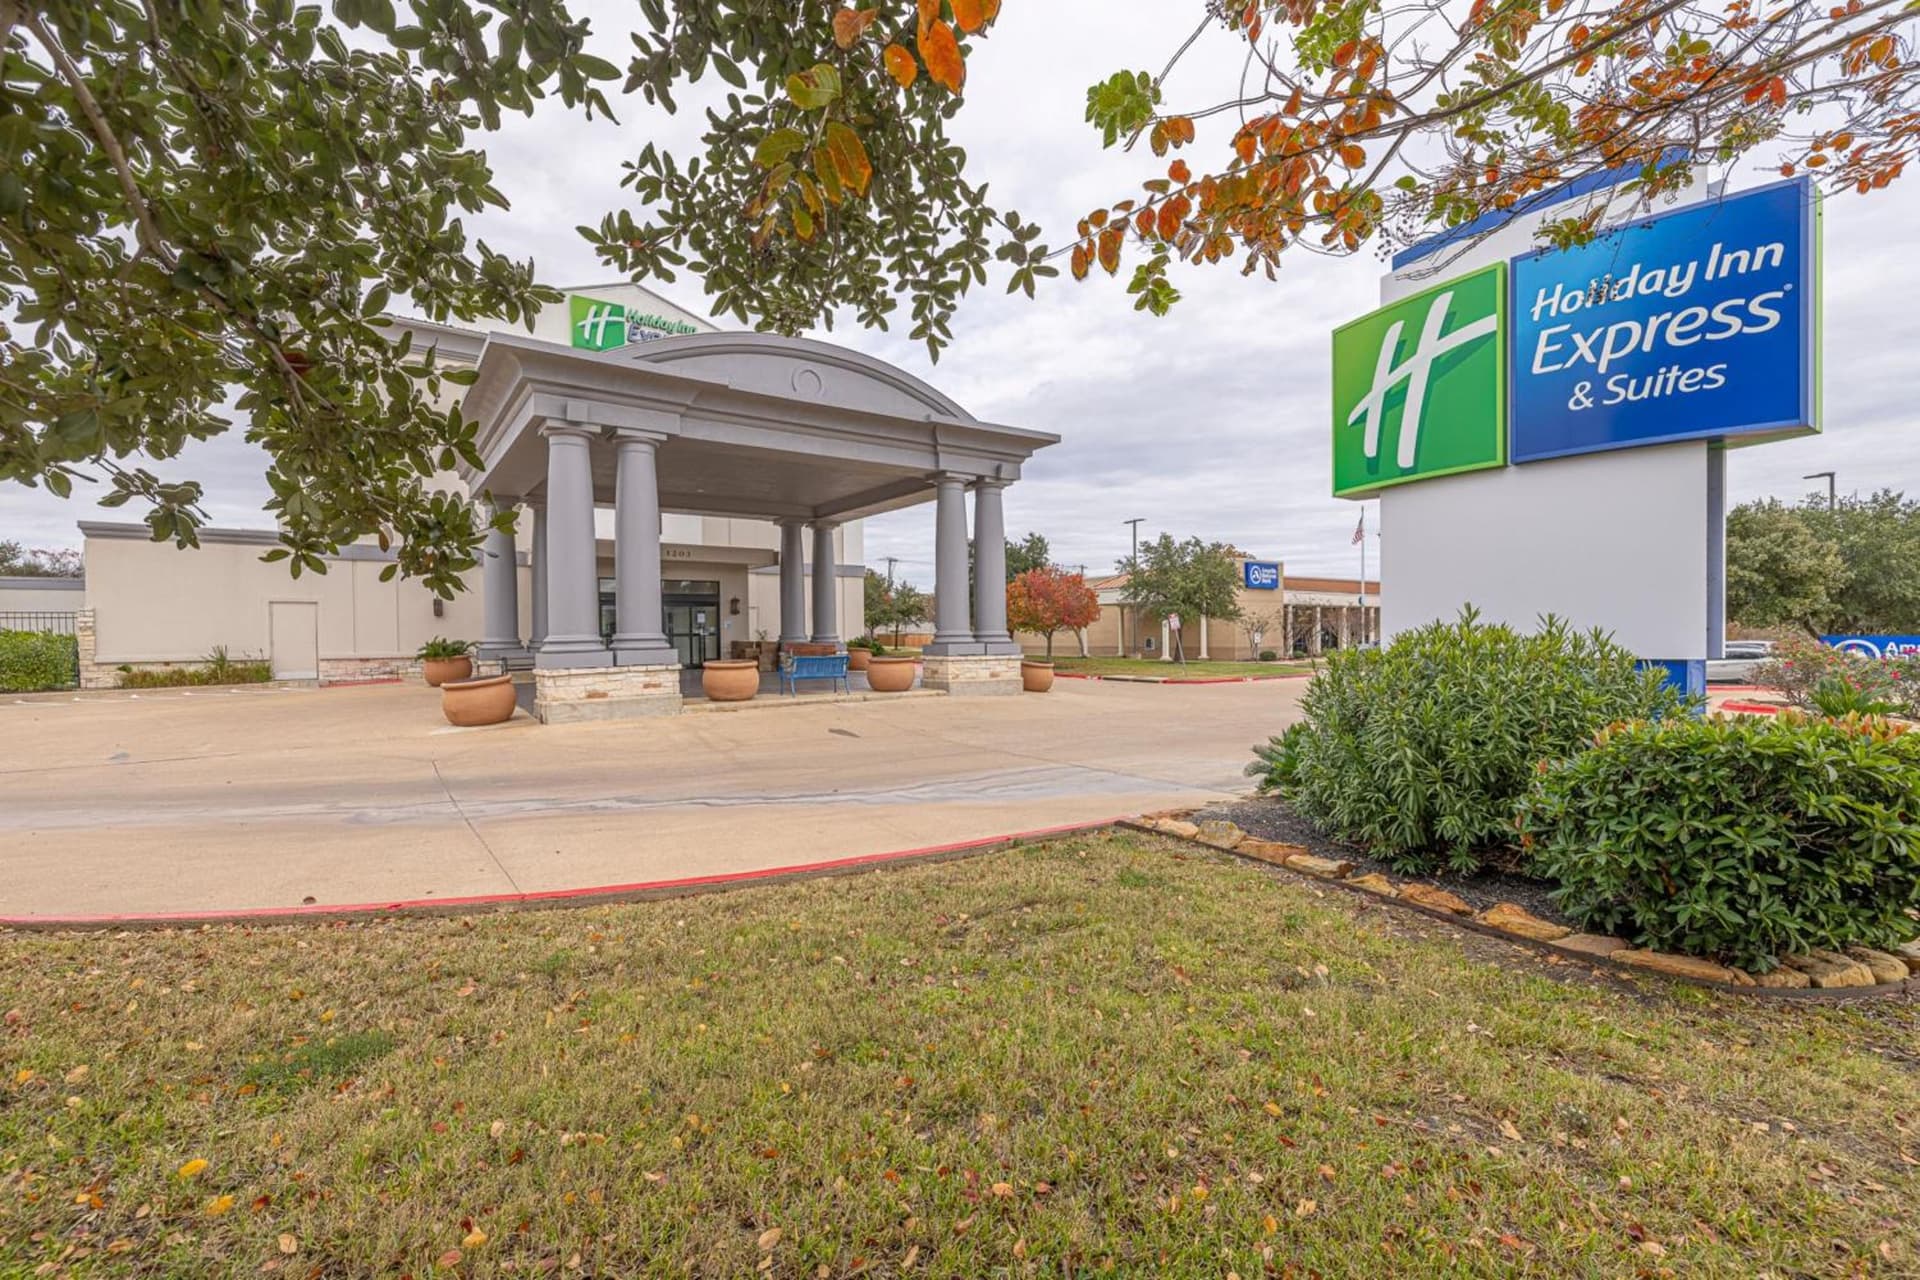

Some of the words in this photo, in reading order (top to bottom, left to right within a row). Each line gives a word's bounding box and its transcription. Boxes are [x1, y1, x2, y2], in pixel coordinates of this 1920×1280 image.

[1530, 261, 1698, 321] Holiday
[1704, 242, 1785, 281] Inn
[625, 308, 676, 335] Holiday
[1531, 291, 1785, 374] Express
[1567, 381, 1595, 411] &
[1602, 363, 1728, 405] Suites
